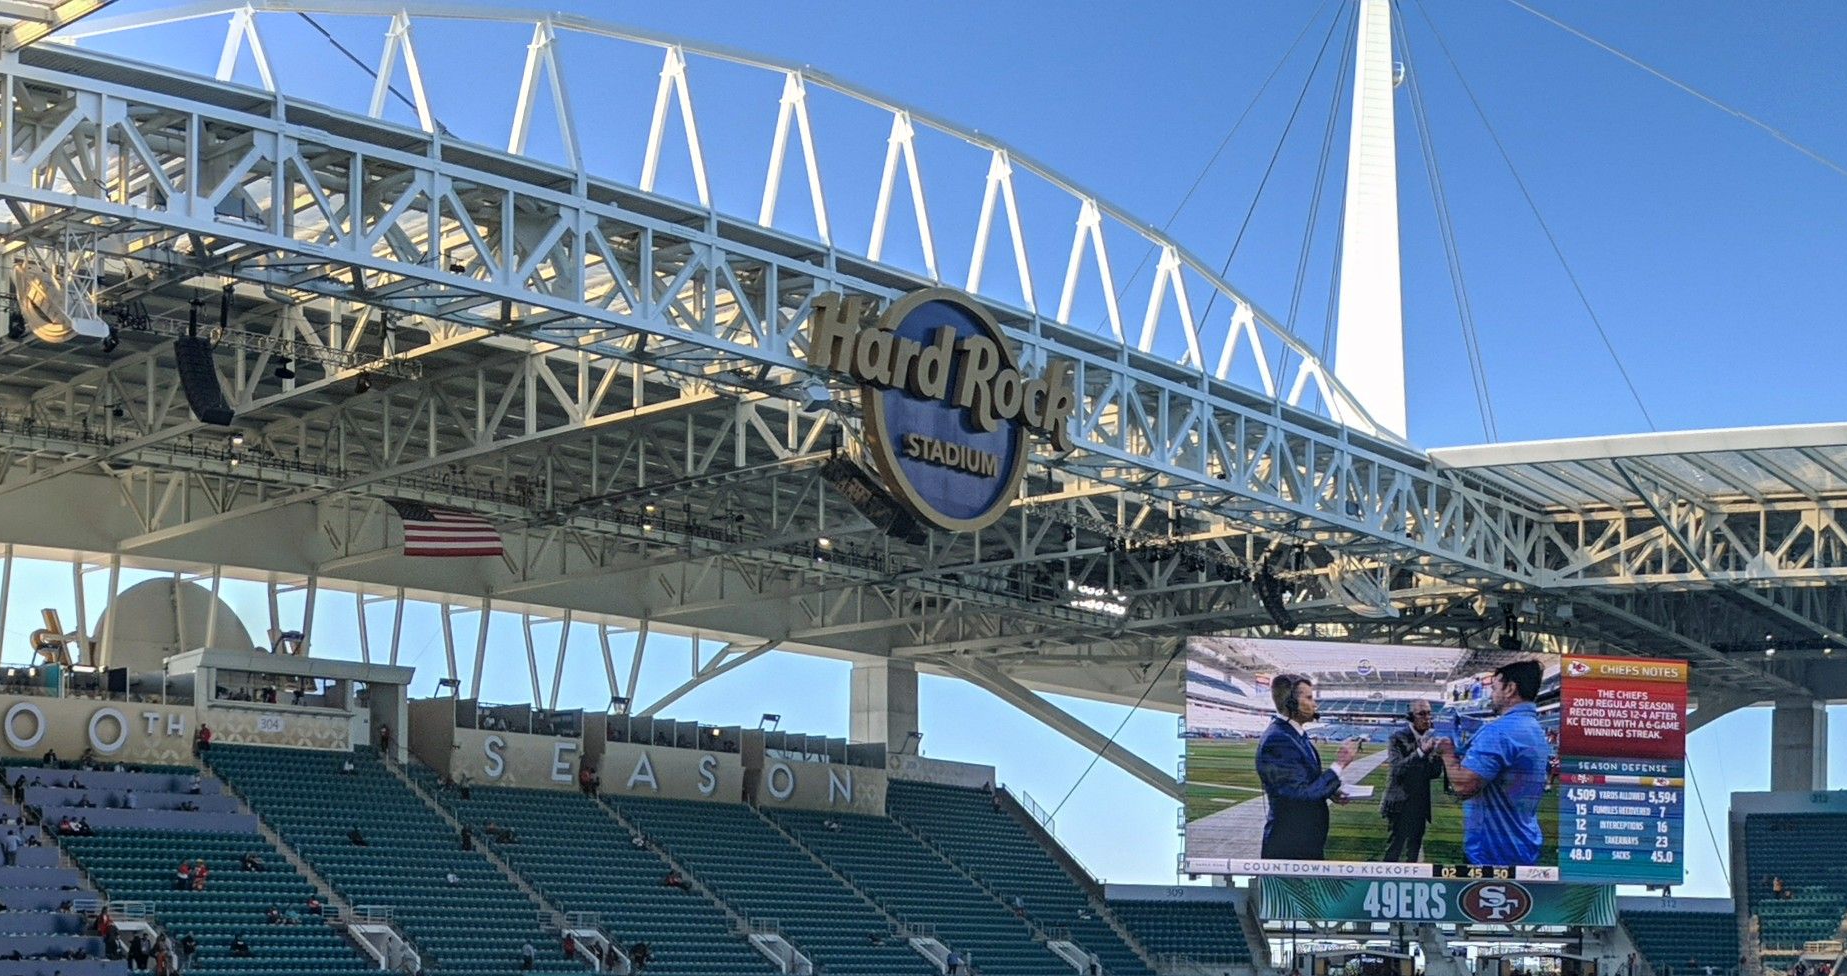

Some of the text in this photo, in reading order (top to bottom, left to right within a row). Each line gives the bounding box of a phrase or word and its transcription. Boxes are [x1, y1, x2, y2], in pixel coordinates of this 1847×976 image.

[807, 290, 1075, 452] Hard Rock
[906, 434, 998, 478] STADIUM
[1600, 665, 1679, 678] CHIEFS NOTES
[1597, 690, 1648, 700] THE CHIEFS
[1574, 698, 1674, 711] 2019 REGULAR SEASON
[260, 718, 279, 731] 304
[484, 735, 853, 804] SEASON
[1578, 762, 1667, 774] SEASON DEFENSE
[1243, 862, 1330, 874] COUNTDOWN
[1338, 864, 1355, 874] TO
[1361, 864, 1419, 876] KICKOFF
[1363, 880, 1446, 918] 49ERS
